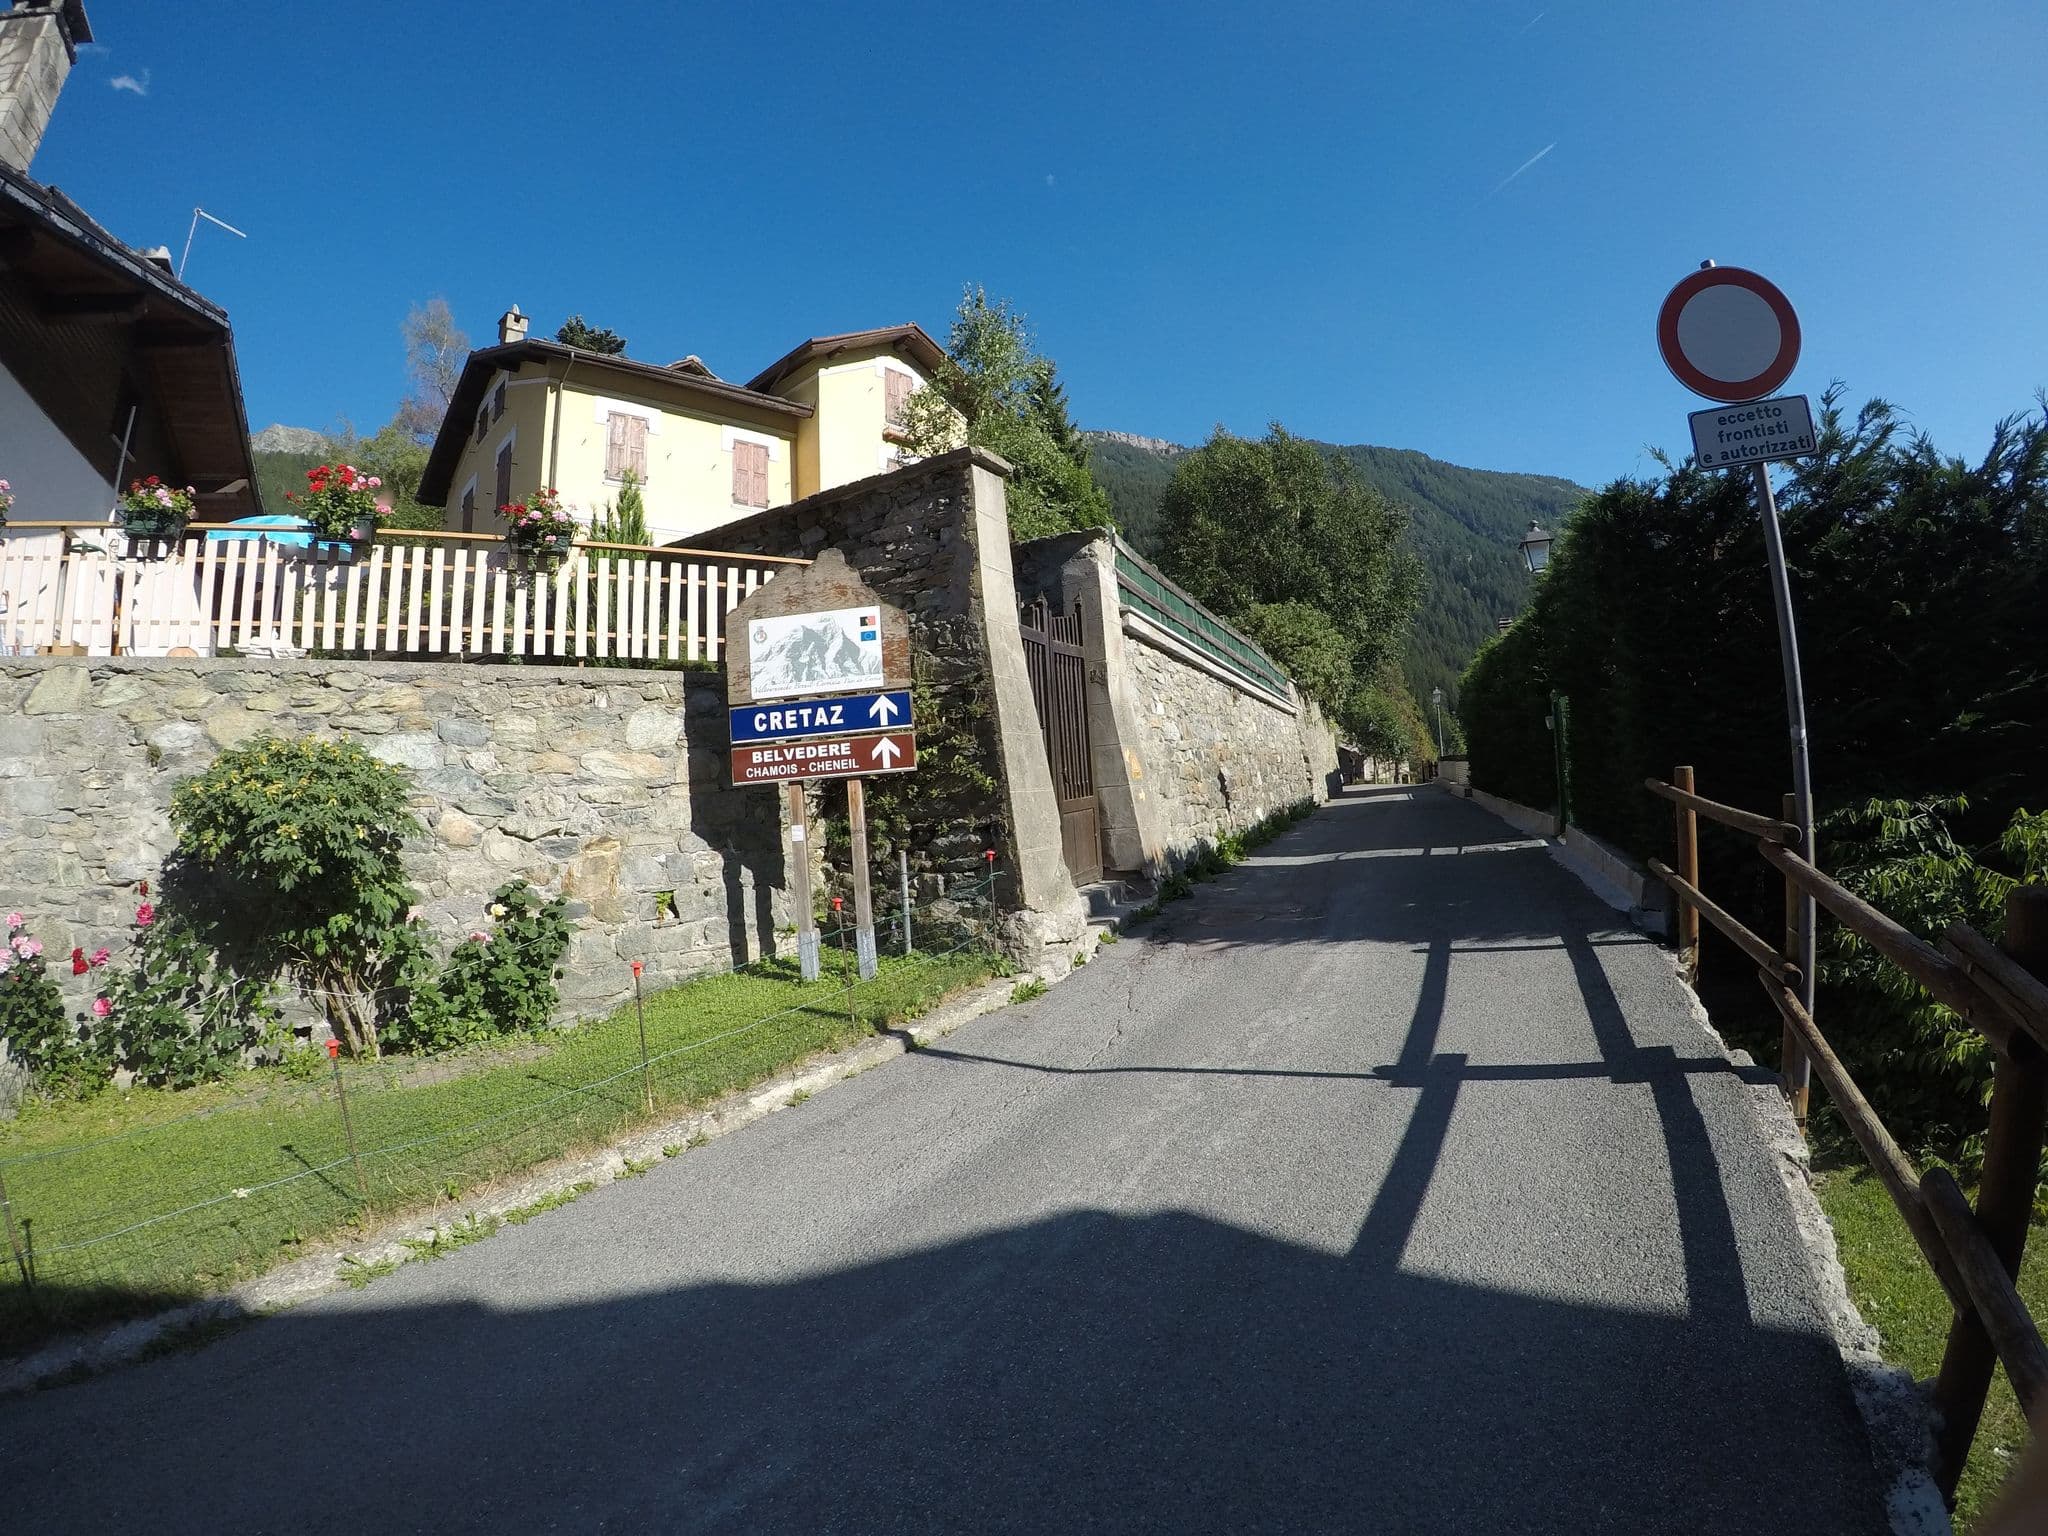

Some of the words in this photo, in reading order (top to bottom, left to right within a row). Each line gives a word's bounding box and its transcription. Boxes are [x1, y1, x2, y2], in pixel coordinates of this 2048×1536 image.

[1718, 406, 1782, 426] eccetto
[1718, 421, 1789, 443] frontisti
[1703, 452, 1713, 464] e
[1721, 436, 1811, 462] autorizzati
[754, 705, 844, 732] CRETAZ
[752, 743, 851, 763] BELVEDERE
[746, 762, 797, 778] CHAMOIS
[809, 759, 859, 773] CHENEIL
